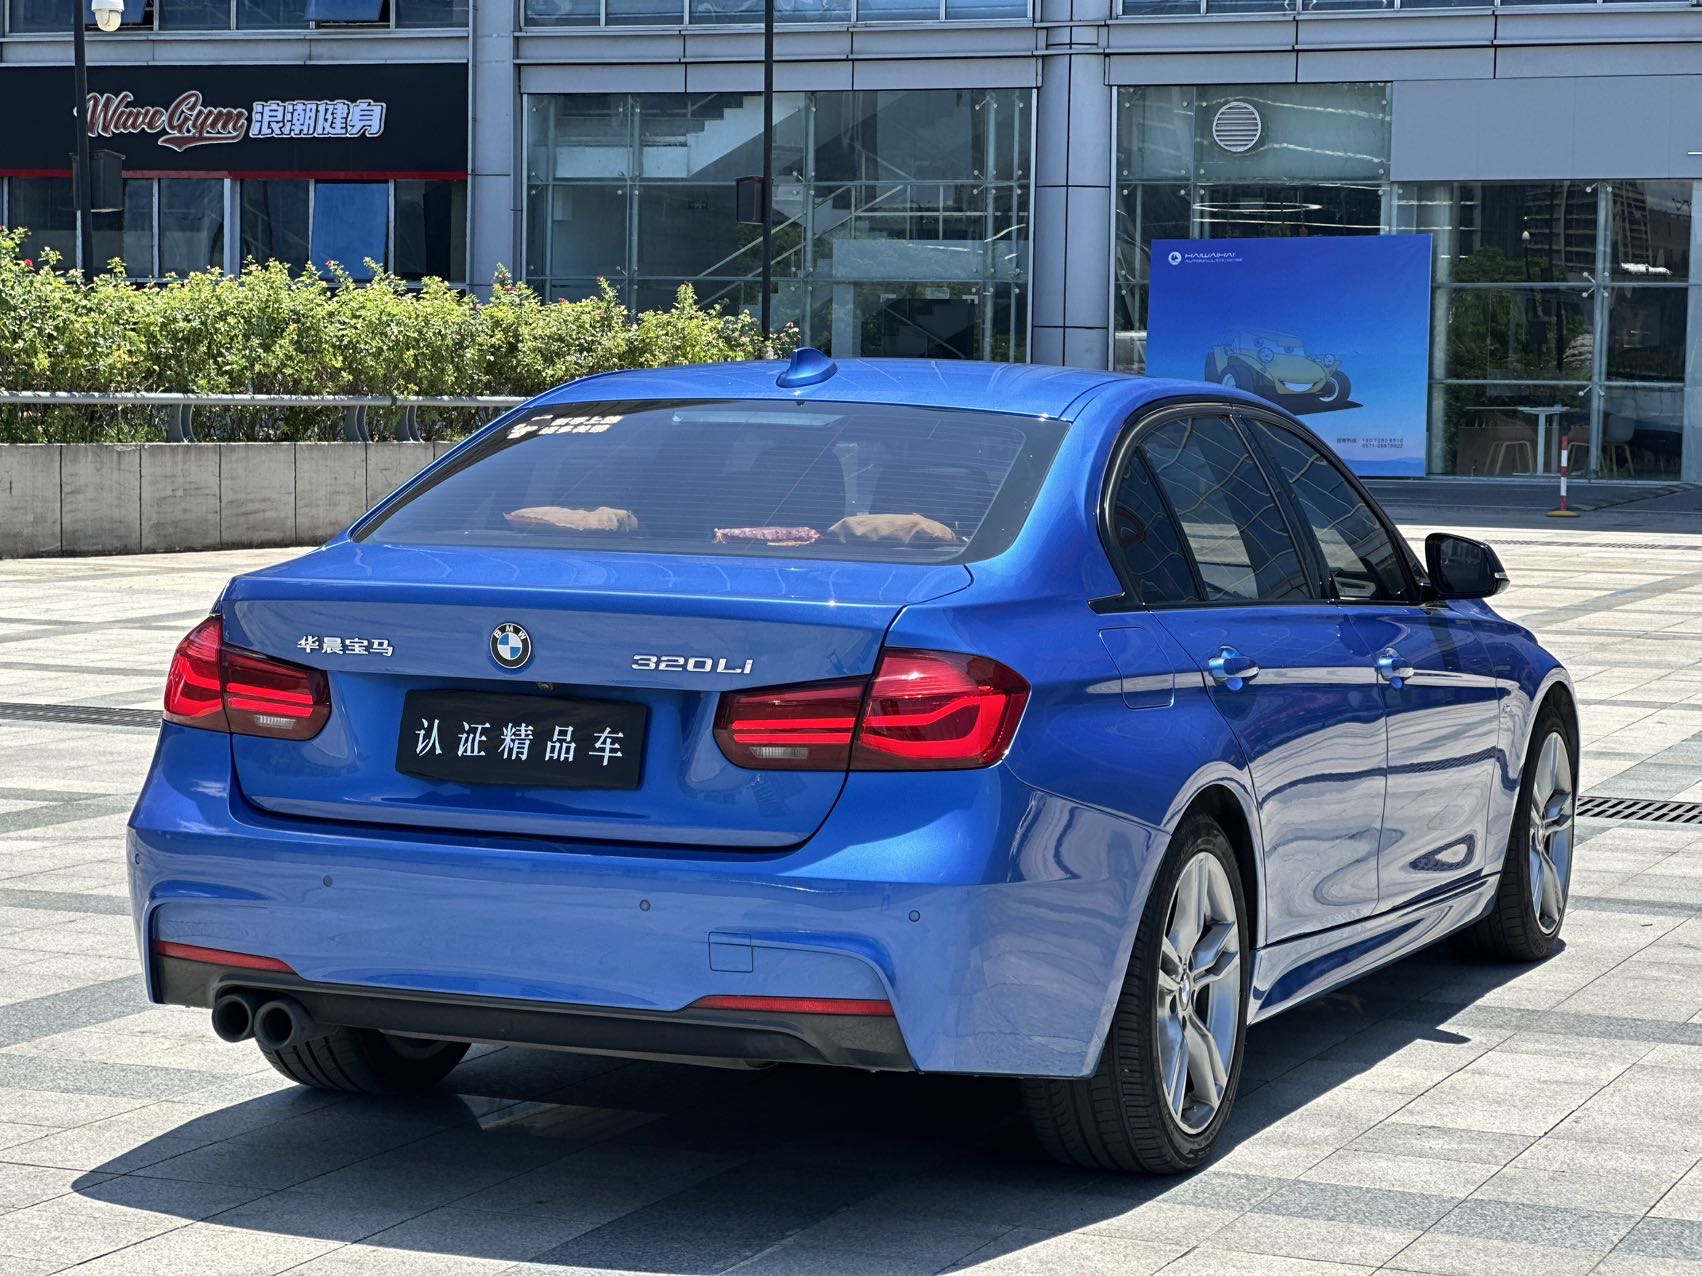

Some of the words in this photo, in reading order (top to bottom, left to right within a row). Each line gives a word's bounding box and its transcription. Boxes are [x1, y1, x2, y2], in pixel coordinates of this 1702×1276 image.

[74, 92, 165, 137] Wave
[158, 91, 247, 150] Gym
[250, 99, 387, 138] 浪潮健身
[297, 636, 394, 656] 华晨宝马
[494, 624, 527, 640] BMW
[631, 655, 754, 675] 320Li
[414, 718, 625, 766] 认证精品车
